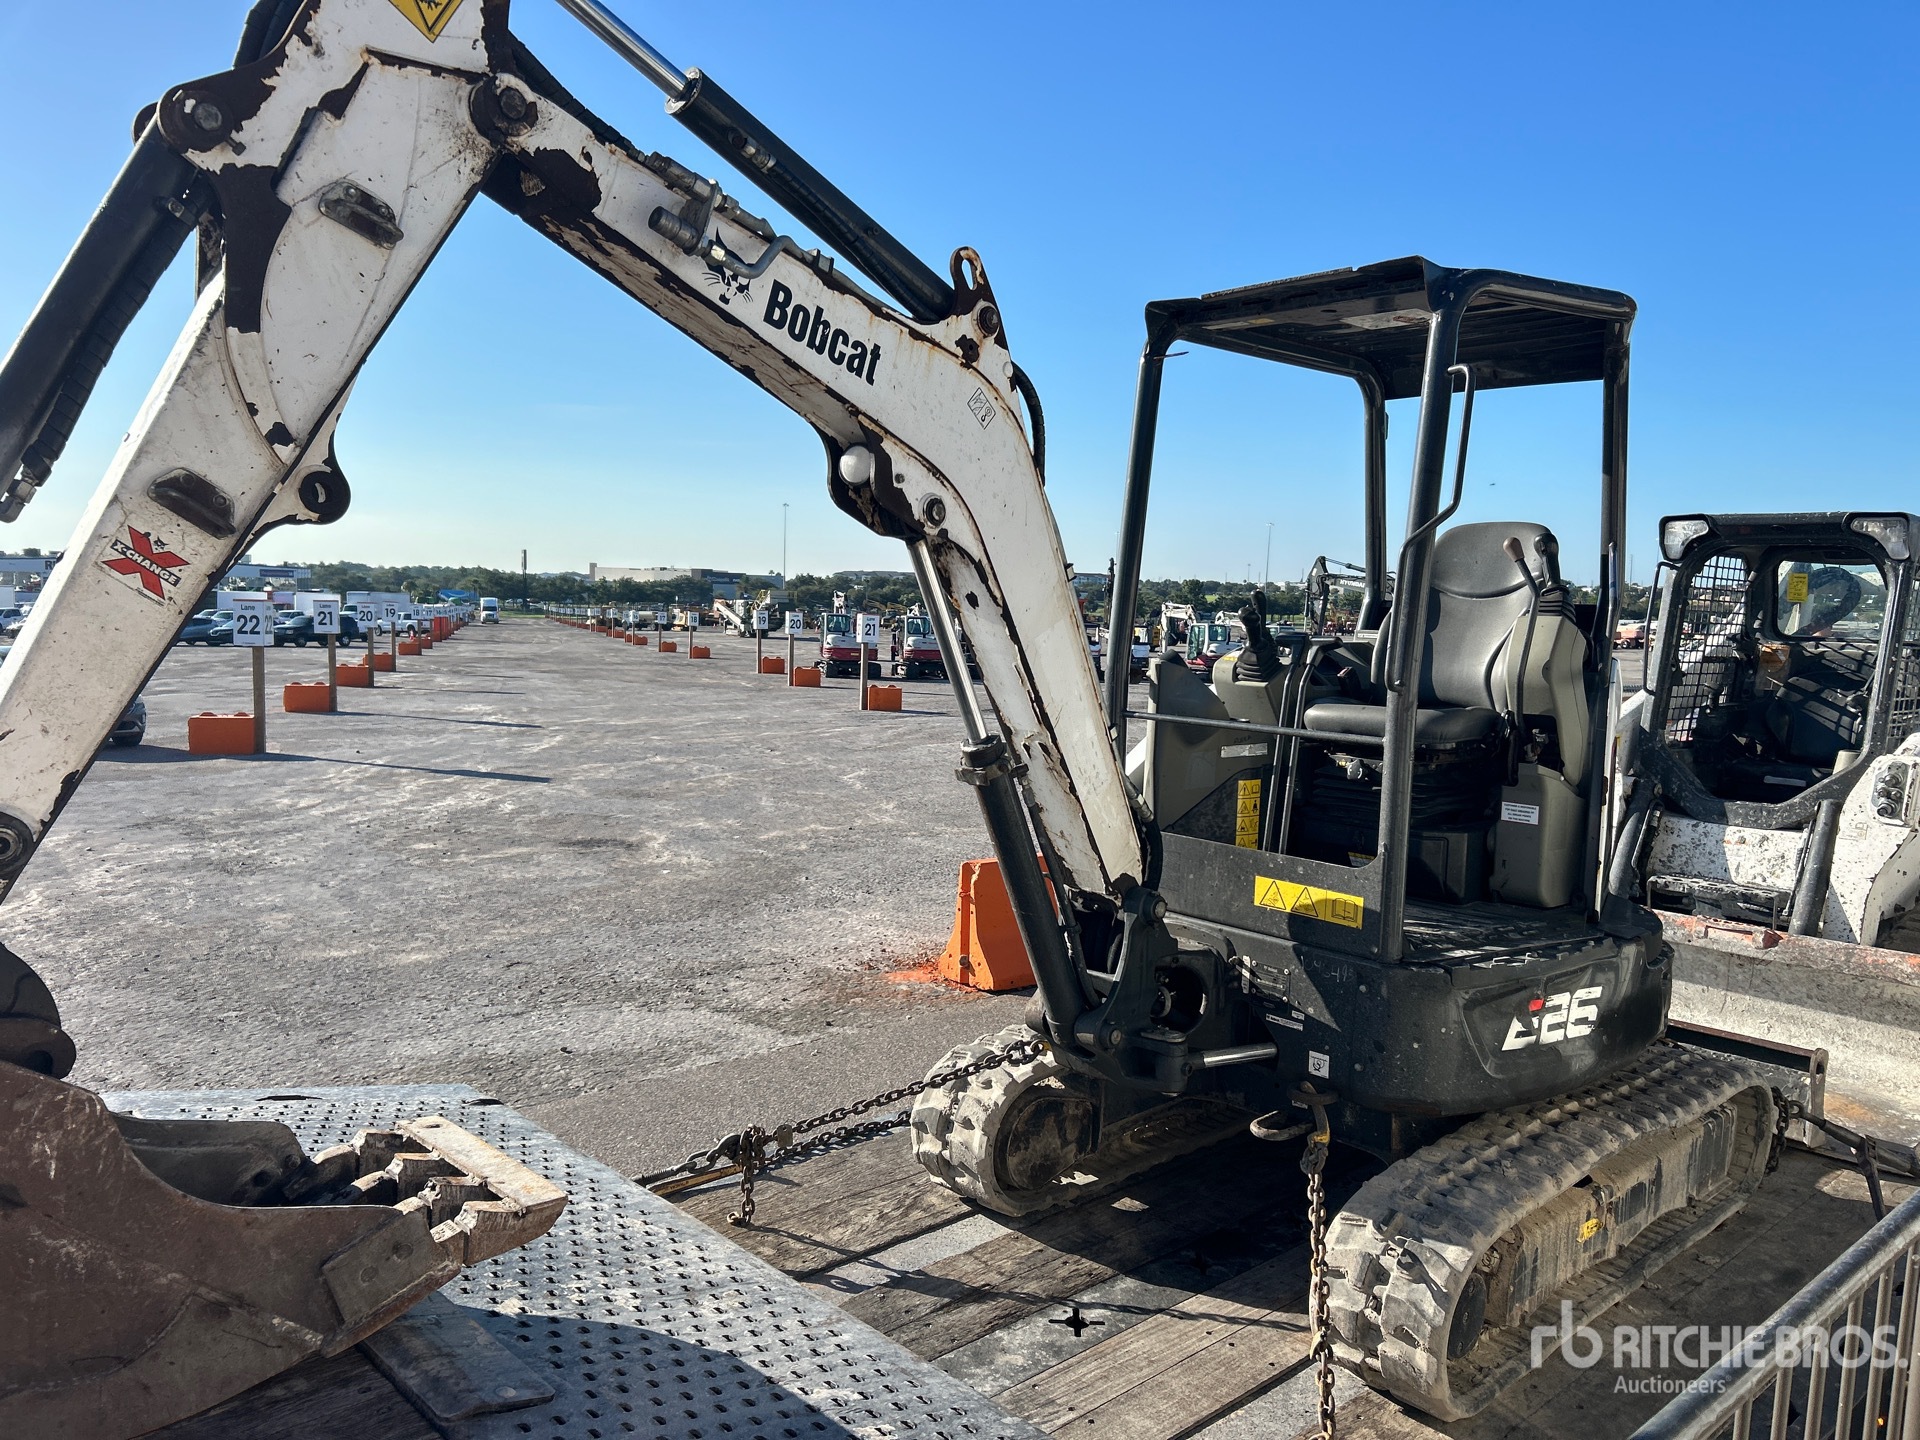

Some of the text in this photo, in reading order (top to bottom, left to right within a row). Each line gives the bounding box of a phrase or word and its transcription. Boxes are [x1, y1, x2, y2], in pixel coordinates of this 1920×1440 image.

[763, 279, 881, 386] Bobcat
[113, 541, 178, 585] X-CHANGE
[317, 611, 333, 626] 21
[359, 610, 373, 622] 20
[384, 608, 396, 618] 19
[690, 615, 698, 623] 18
[236, 614, 261, 635] 22
[758, 616, 767, 625] 19
[789, 619, 802, 630] 20
[864, 623, 876, 636] 21
